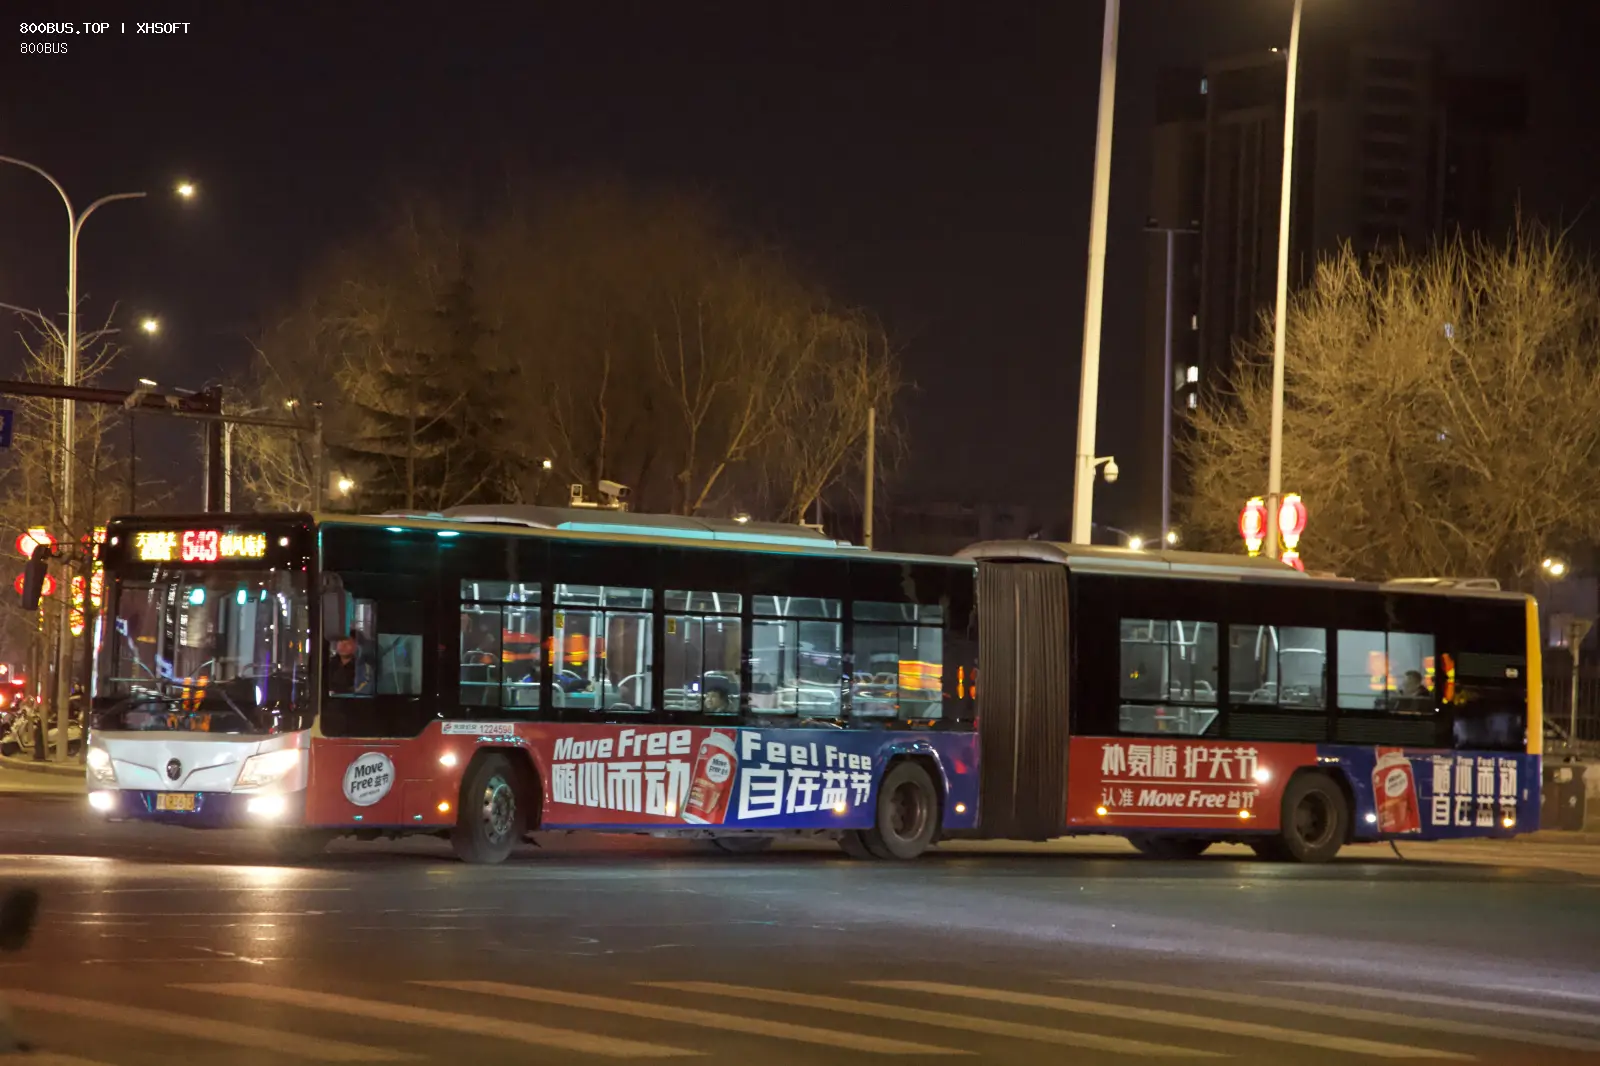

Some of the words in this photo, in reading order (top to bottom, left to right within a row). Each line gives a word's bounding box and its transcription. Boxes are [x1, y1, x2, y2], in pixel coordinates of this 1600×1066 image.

[182, 530, 218, 561] 543
[553, 737, 613, 760] Move
[617, 729, 691, 757] Free
[741, 732, 818, 767] Feel
[825, 745, 872, 769] Free
[354, 761, 384, 779] Move
[1184, 746, 1258, 780] 护关节
[350, 777, 374, 794] Free
[552, 759, 690, 817] 随心而动
[738, 763, 872, 820] 自在益节
[1101, 788, 1134, 807] 认准
[1138, 789, 1184, 807] Move
[1187, 790, 1225, 808] Free
